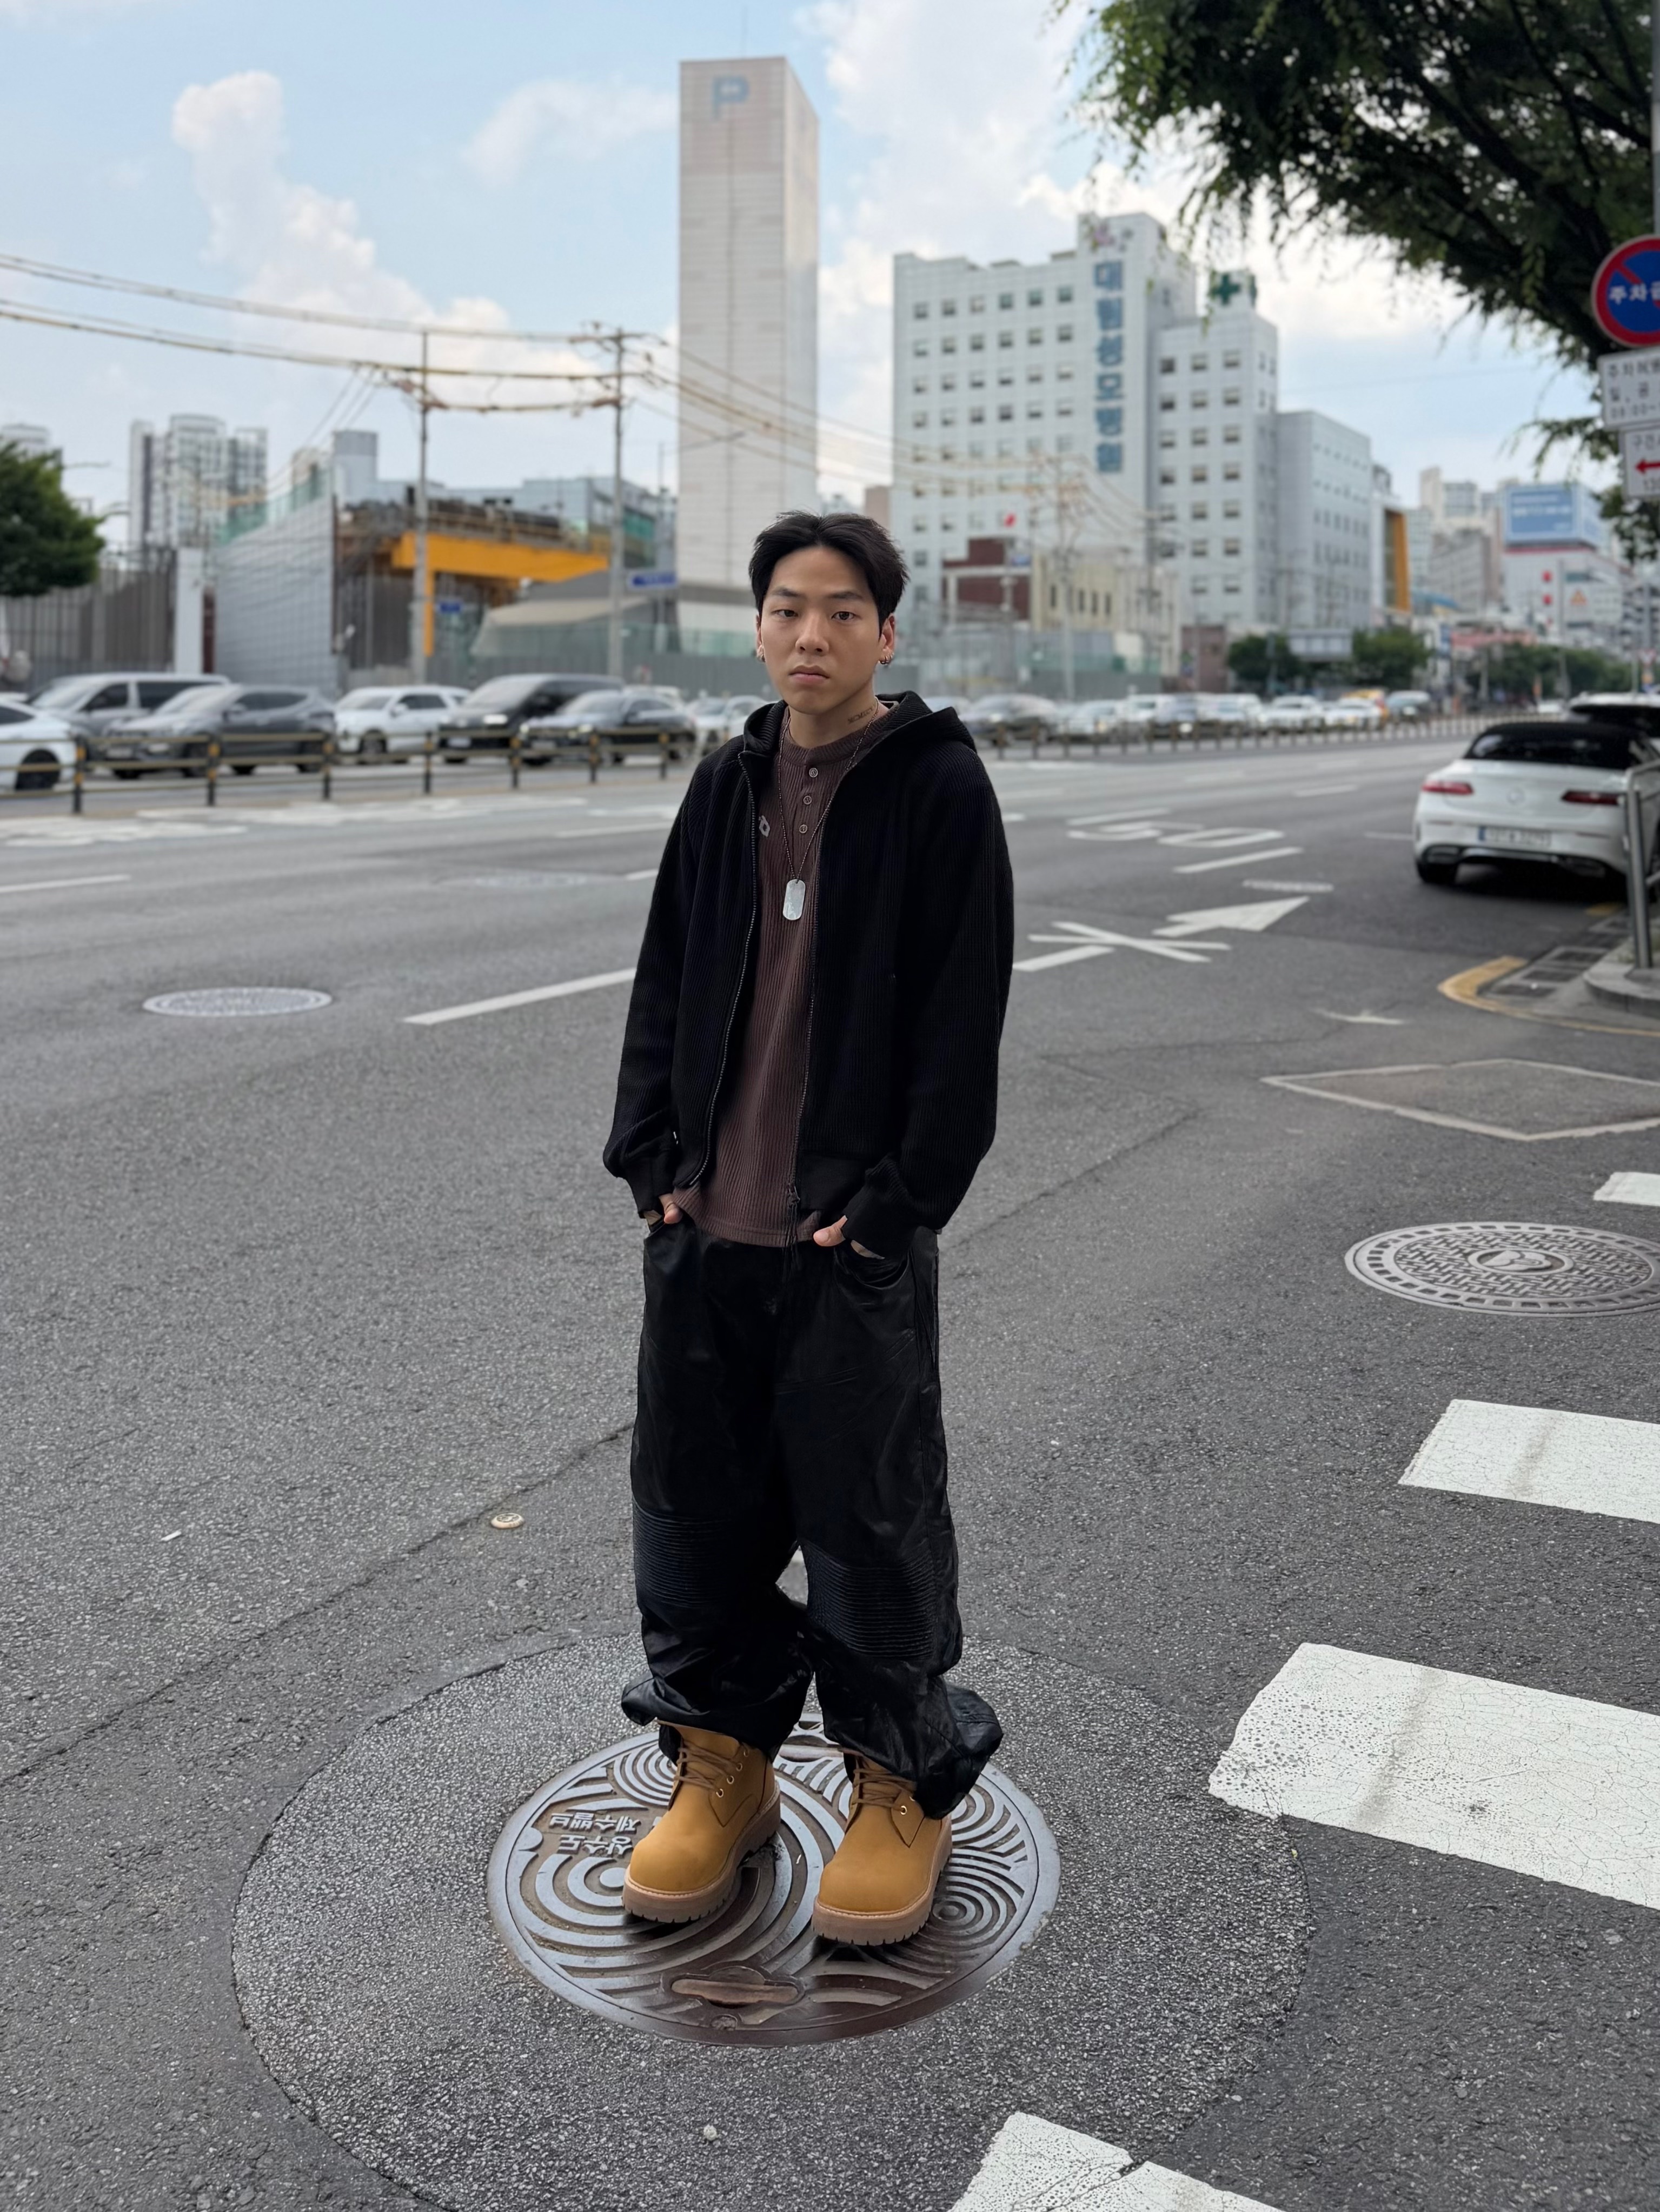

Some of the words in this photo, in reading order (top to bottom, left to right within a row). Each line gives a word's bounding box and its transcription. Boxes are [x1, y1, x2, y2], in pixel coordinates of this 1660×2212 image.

[712, 76, 749, 121] P
[549, 1812, 642, 1835] 제수밸브
[557, 1835, 634, 1856] 상수도
